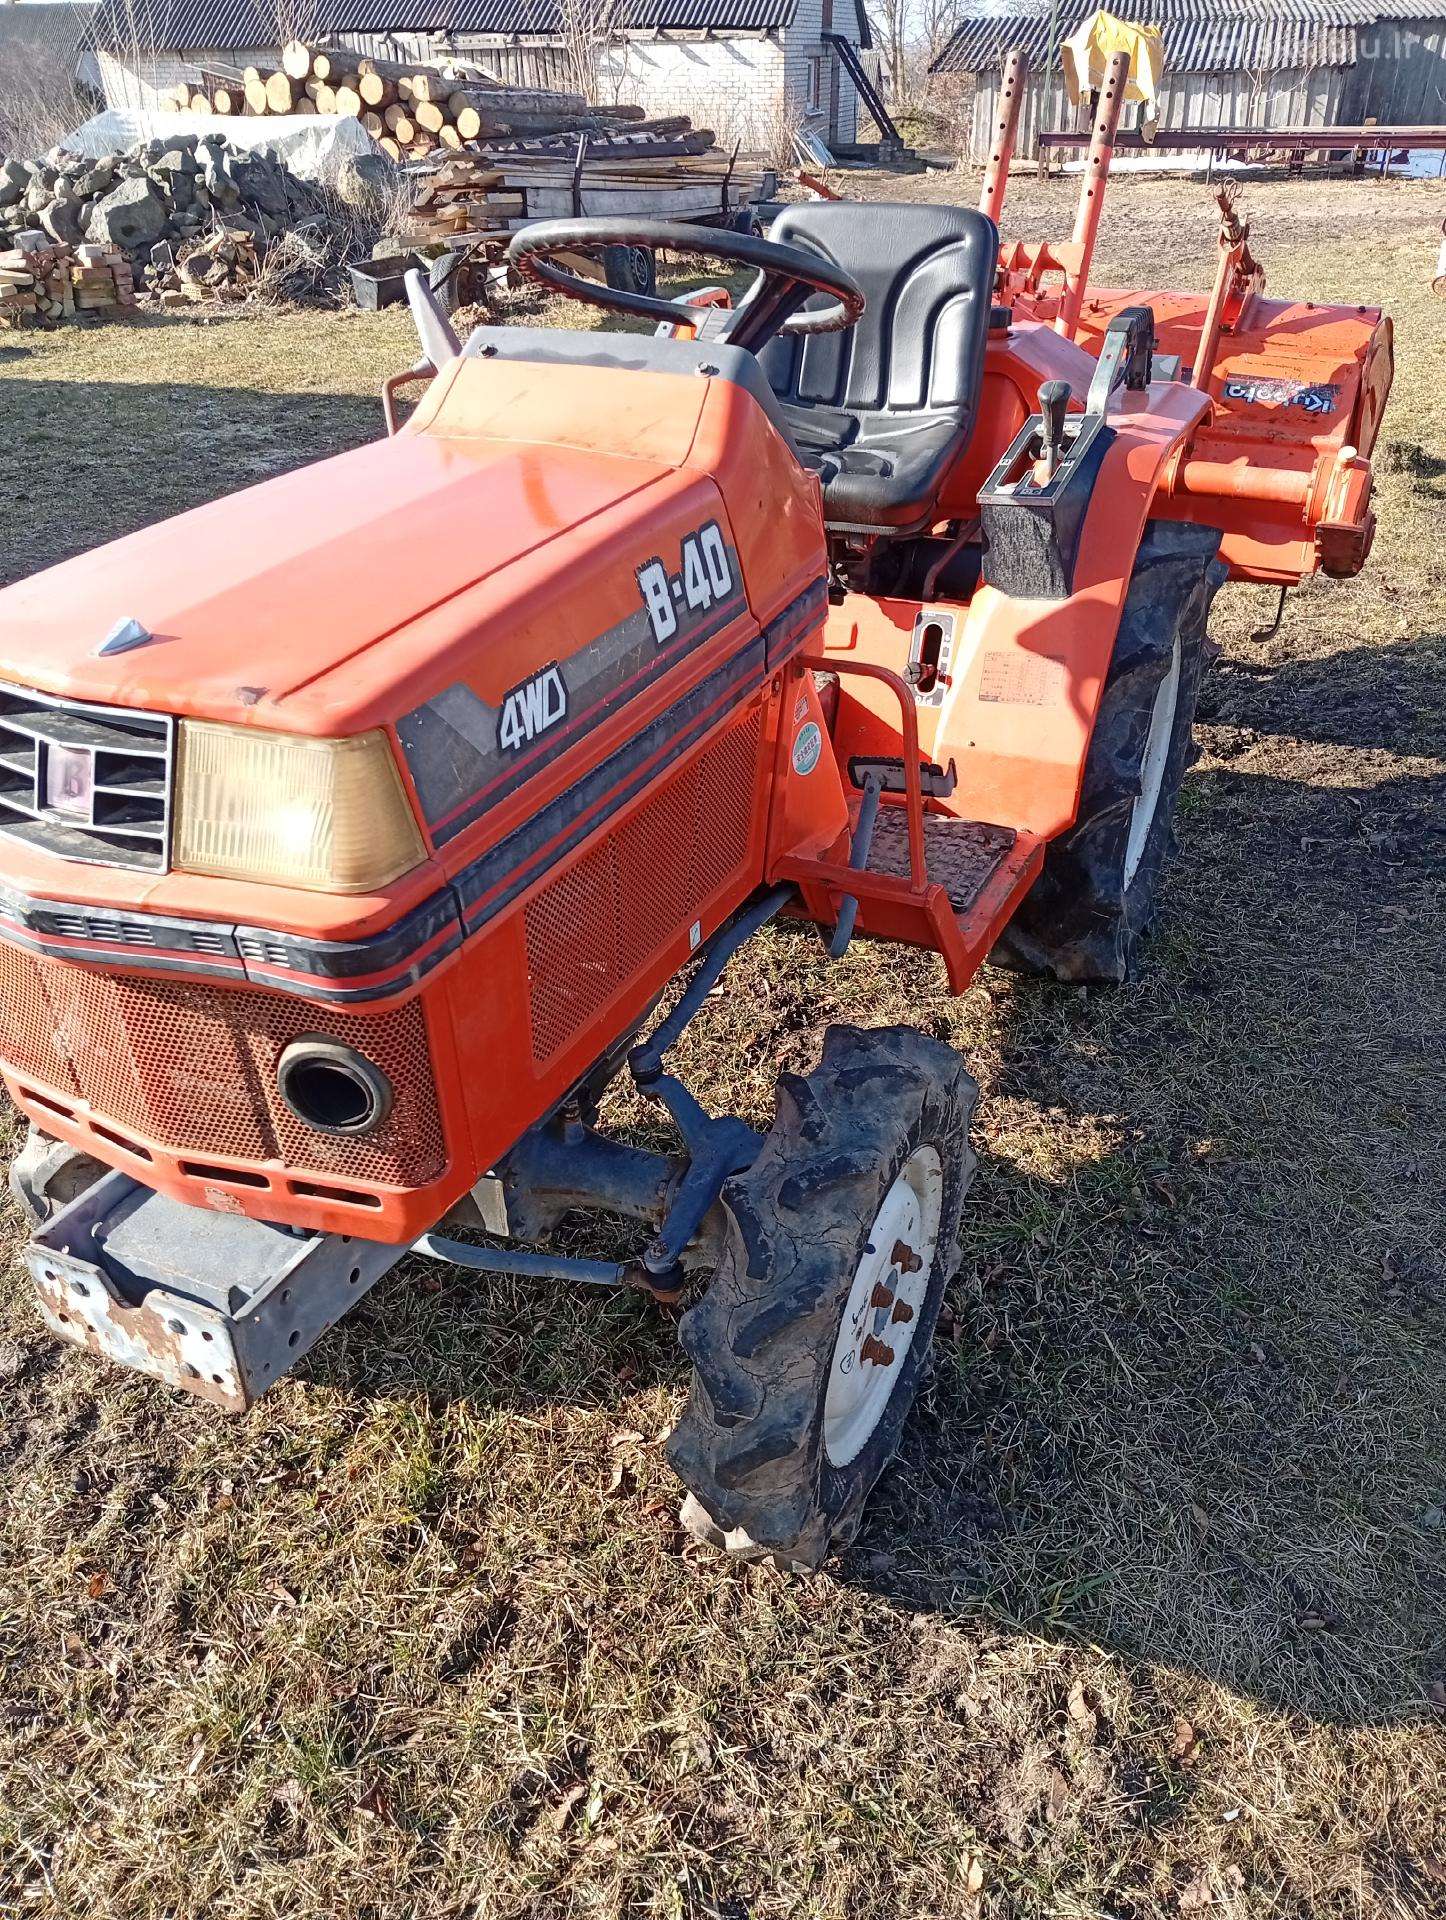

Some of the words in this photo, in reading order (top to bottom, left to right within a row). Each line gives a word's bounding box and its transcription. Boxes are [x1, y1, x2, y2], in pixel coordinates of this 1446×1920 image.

[1227, 384, 1332, 413] Kubota
[637, 522, 734, 644] B-40
[499, 666, 568, 750] 4WD
